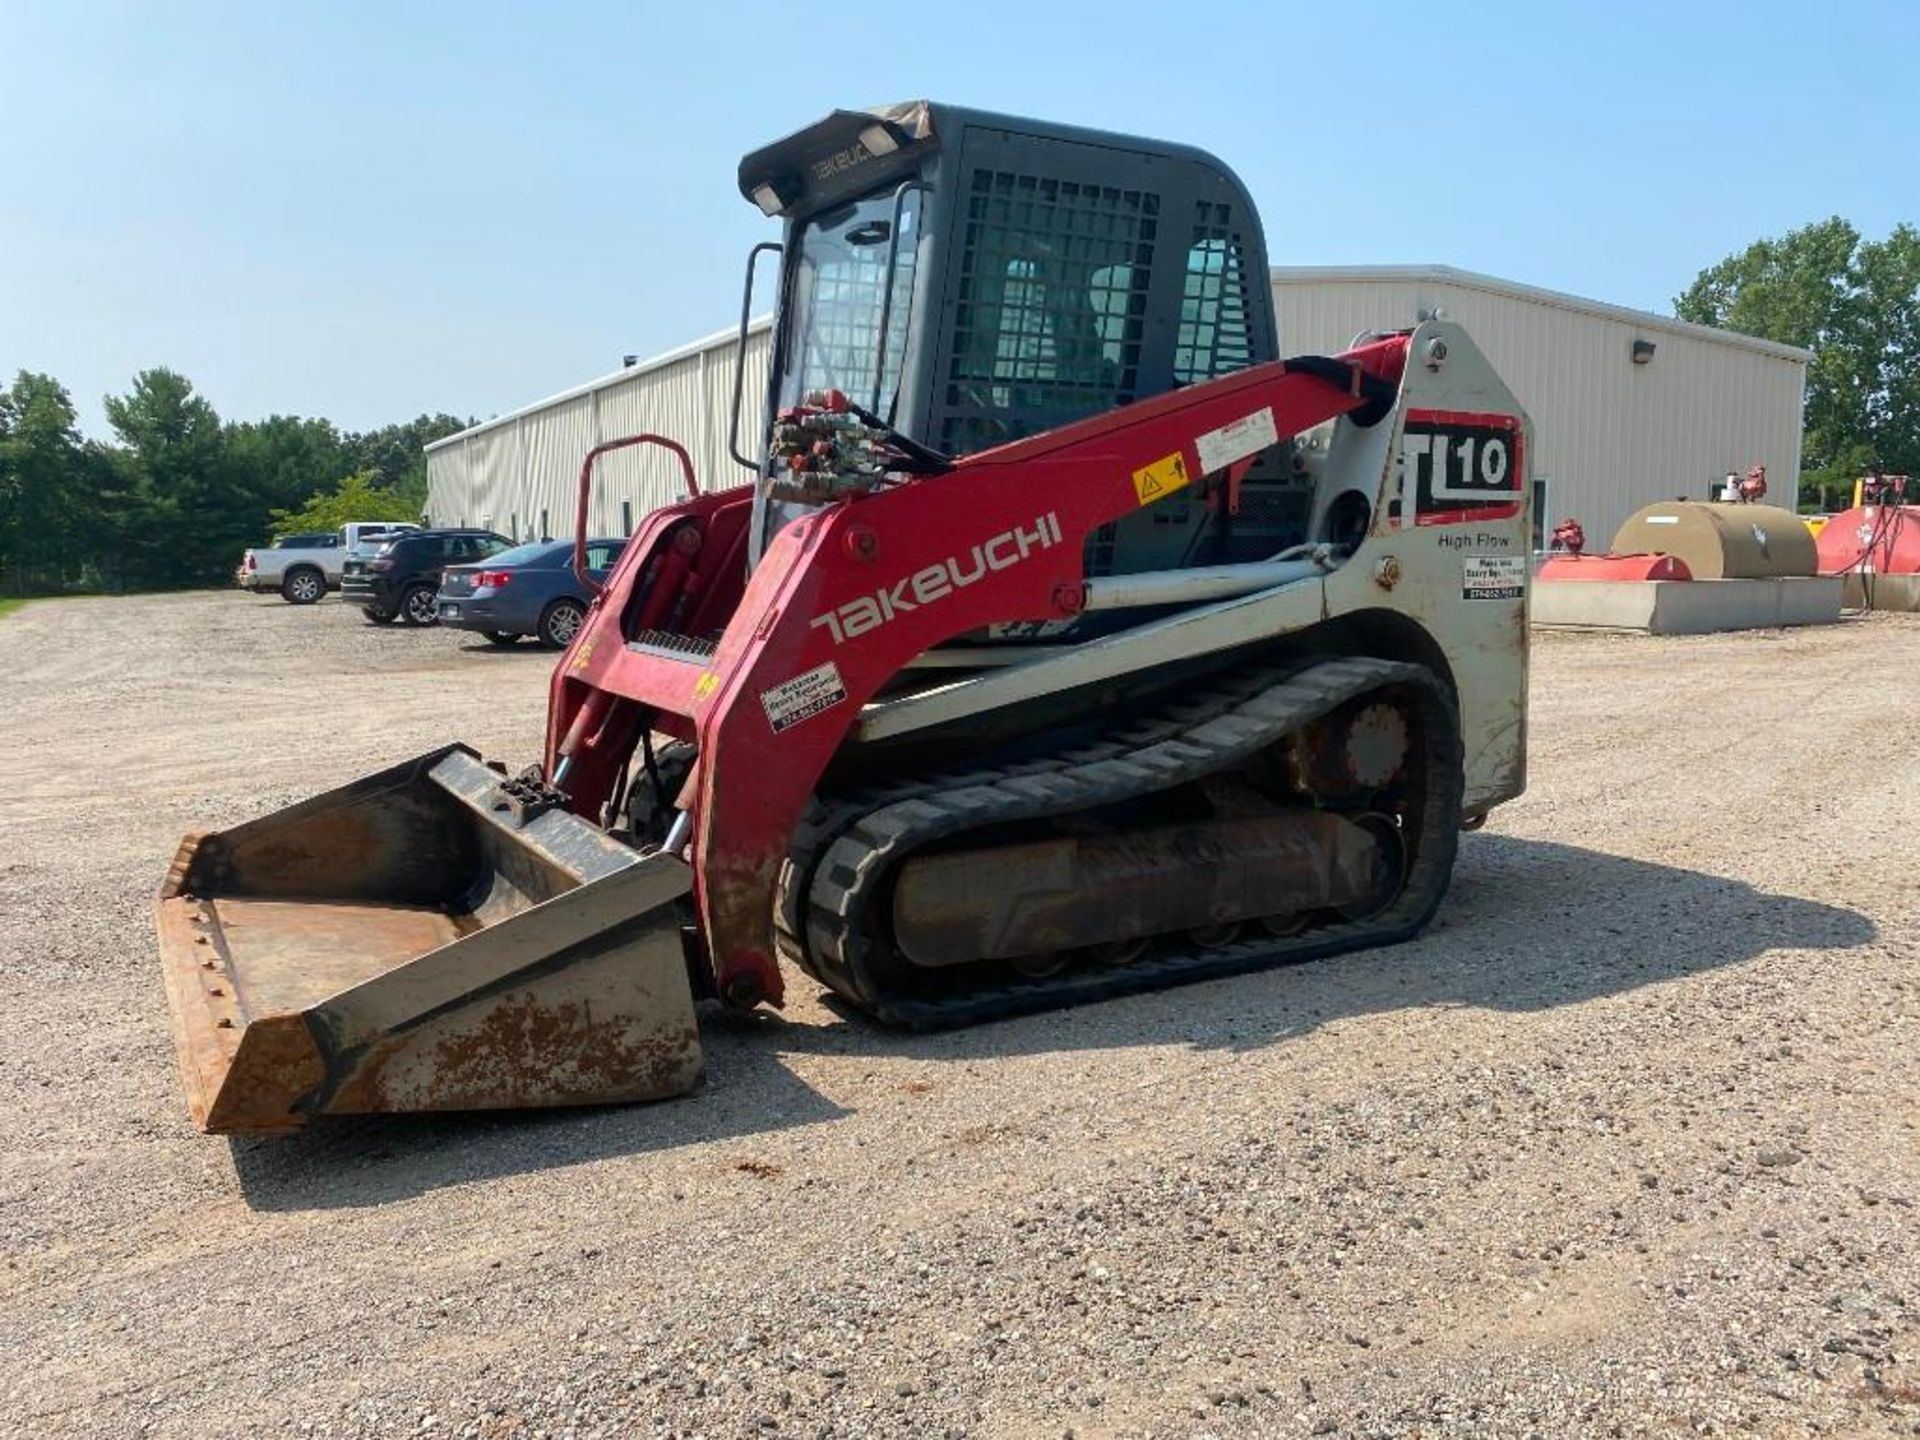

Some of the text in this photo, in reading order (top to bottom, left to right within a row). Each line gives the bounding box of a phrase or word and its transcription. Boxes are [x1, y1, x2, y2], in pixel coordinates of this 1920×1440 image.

[810, 511, 1062, 645] TAKEUCHI
[1438, 533, 1510, 551] High Flow
